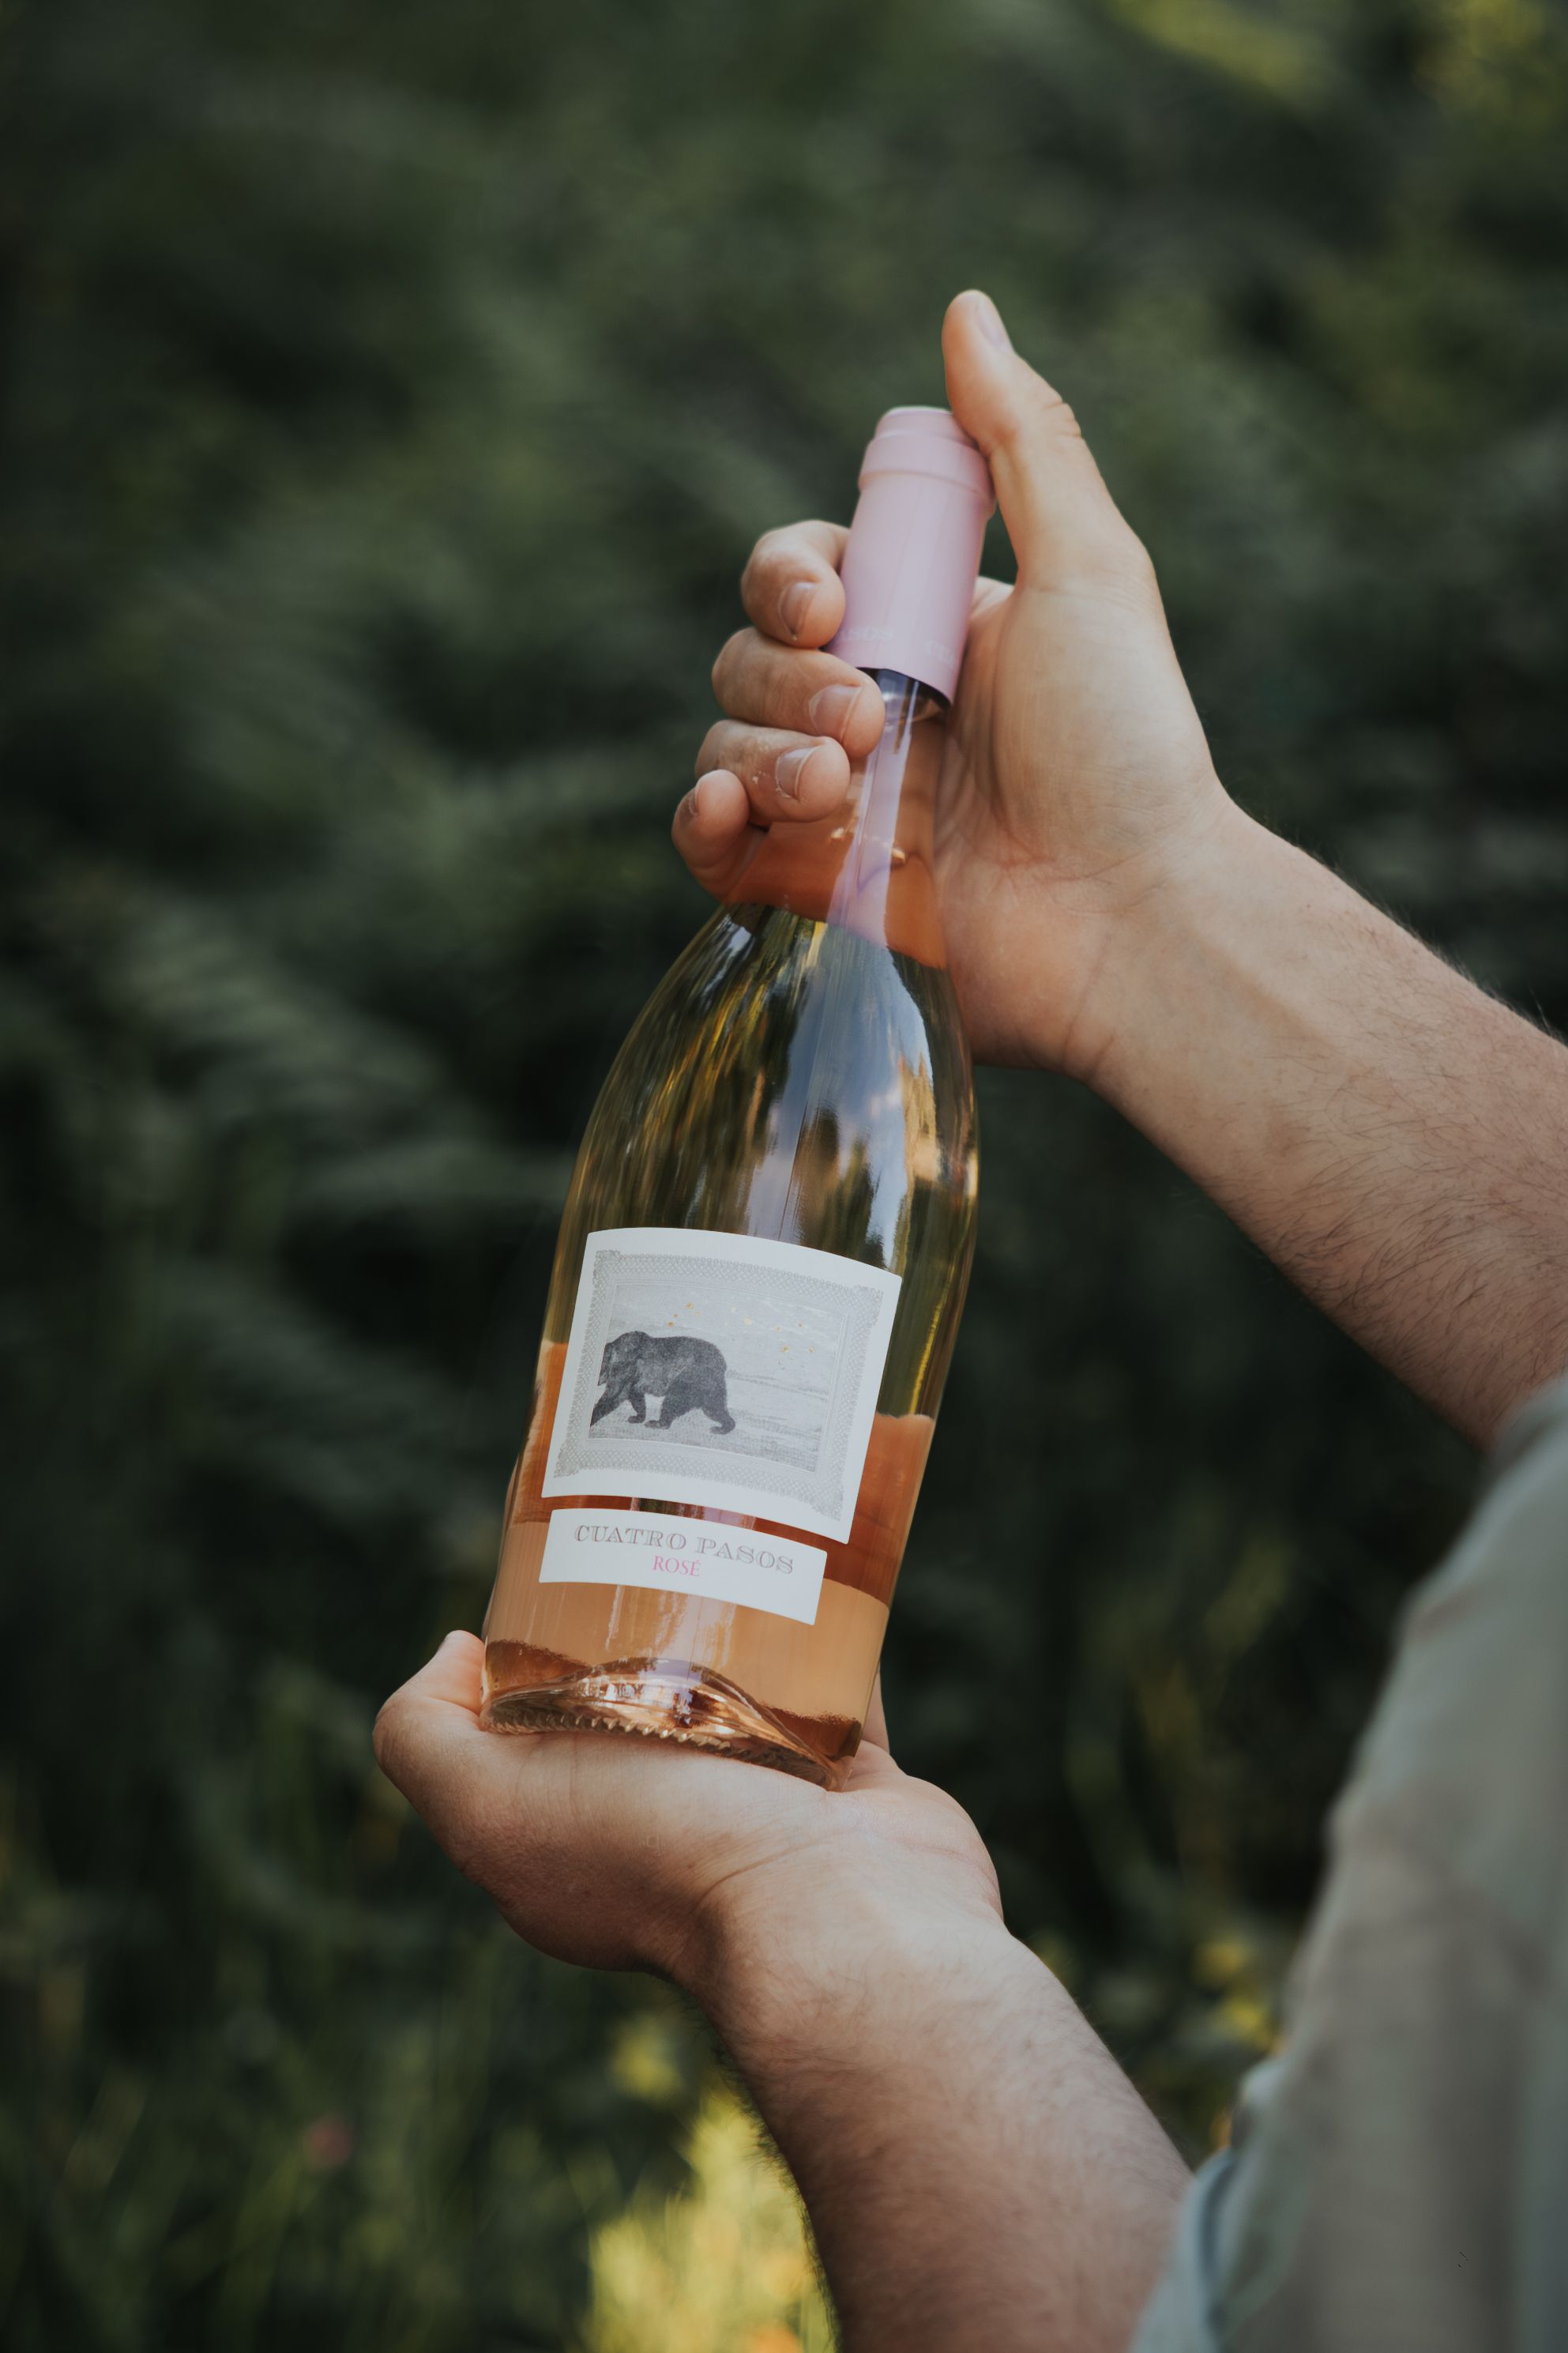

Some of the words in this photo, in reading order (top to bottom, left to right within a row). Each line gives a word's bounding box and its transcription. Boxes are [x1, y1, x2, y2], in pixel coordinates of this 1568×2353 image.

[574, 1524, 687, 1550] CUATRO
[695, 1536, 795, 1575] PASOS
[652, 1554, 701, 1577] ROSÉ
